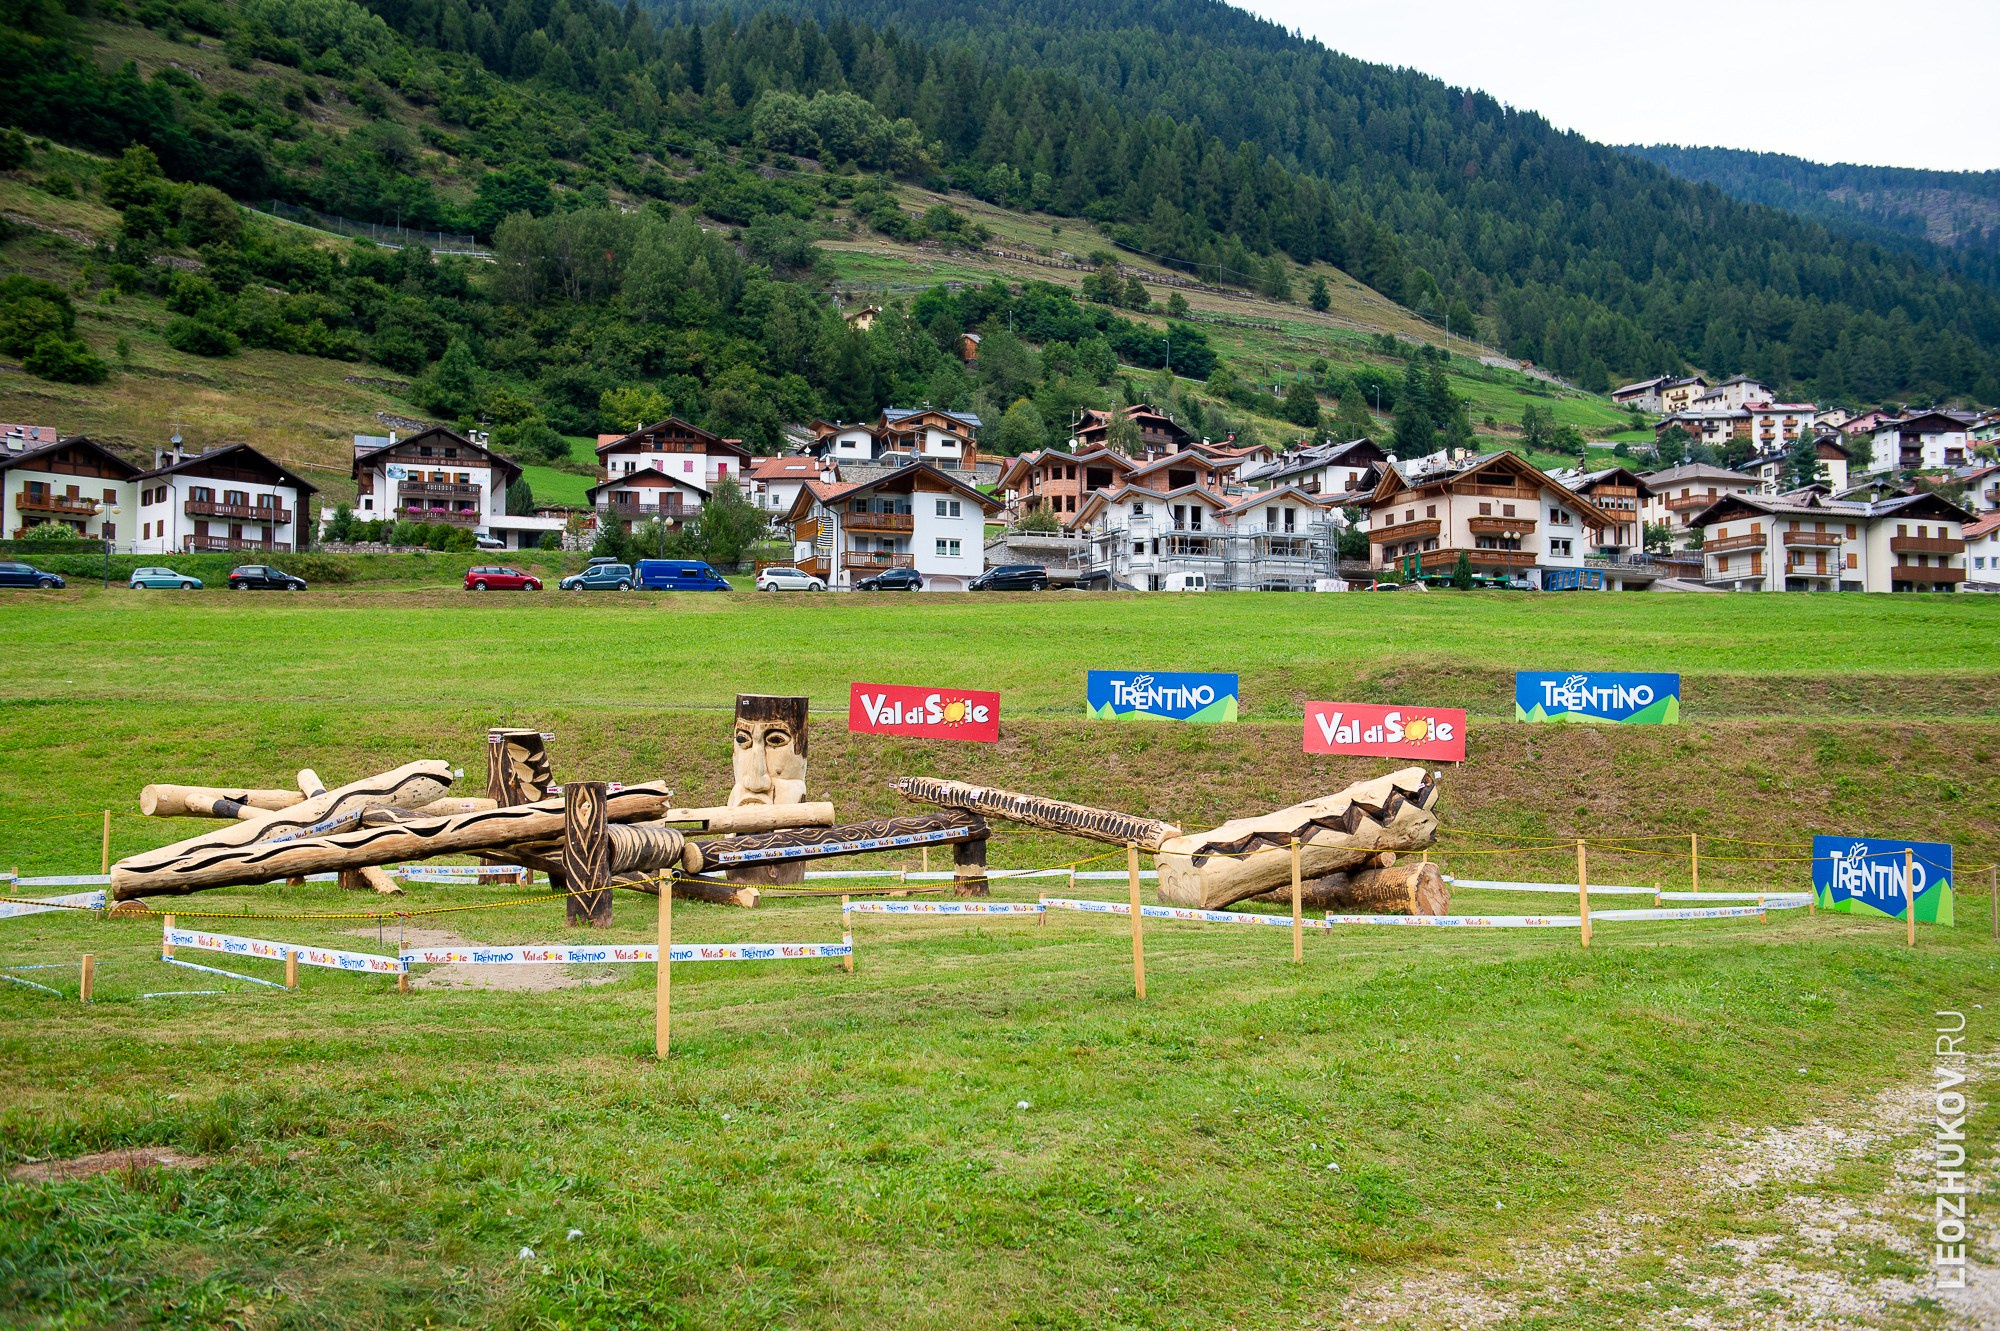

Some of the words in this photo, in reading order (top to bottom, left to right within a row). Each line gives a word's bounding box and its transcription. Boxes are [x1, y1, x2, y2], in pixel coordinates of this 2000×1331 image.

[860, 693, 902, 727] Val
[905, 707, 924, 724] di
[1110, 680, 1215, 710] TRENTINO
[1315, 711, 1361, 746] Val
[1363, 725, 1384, 743] di
